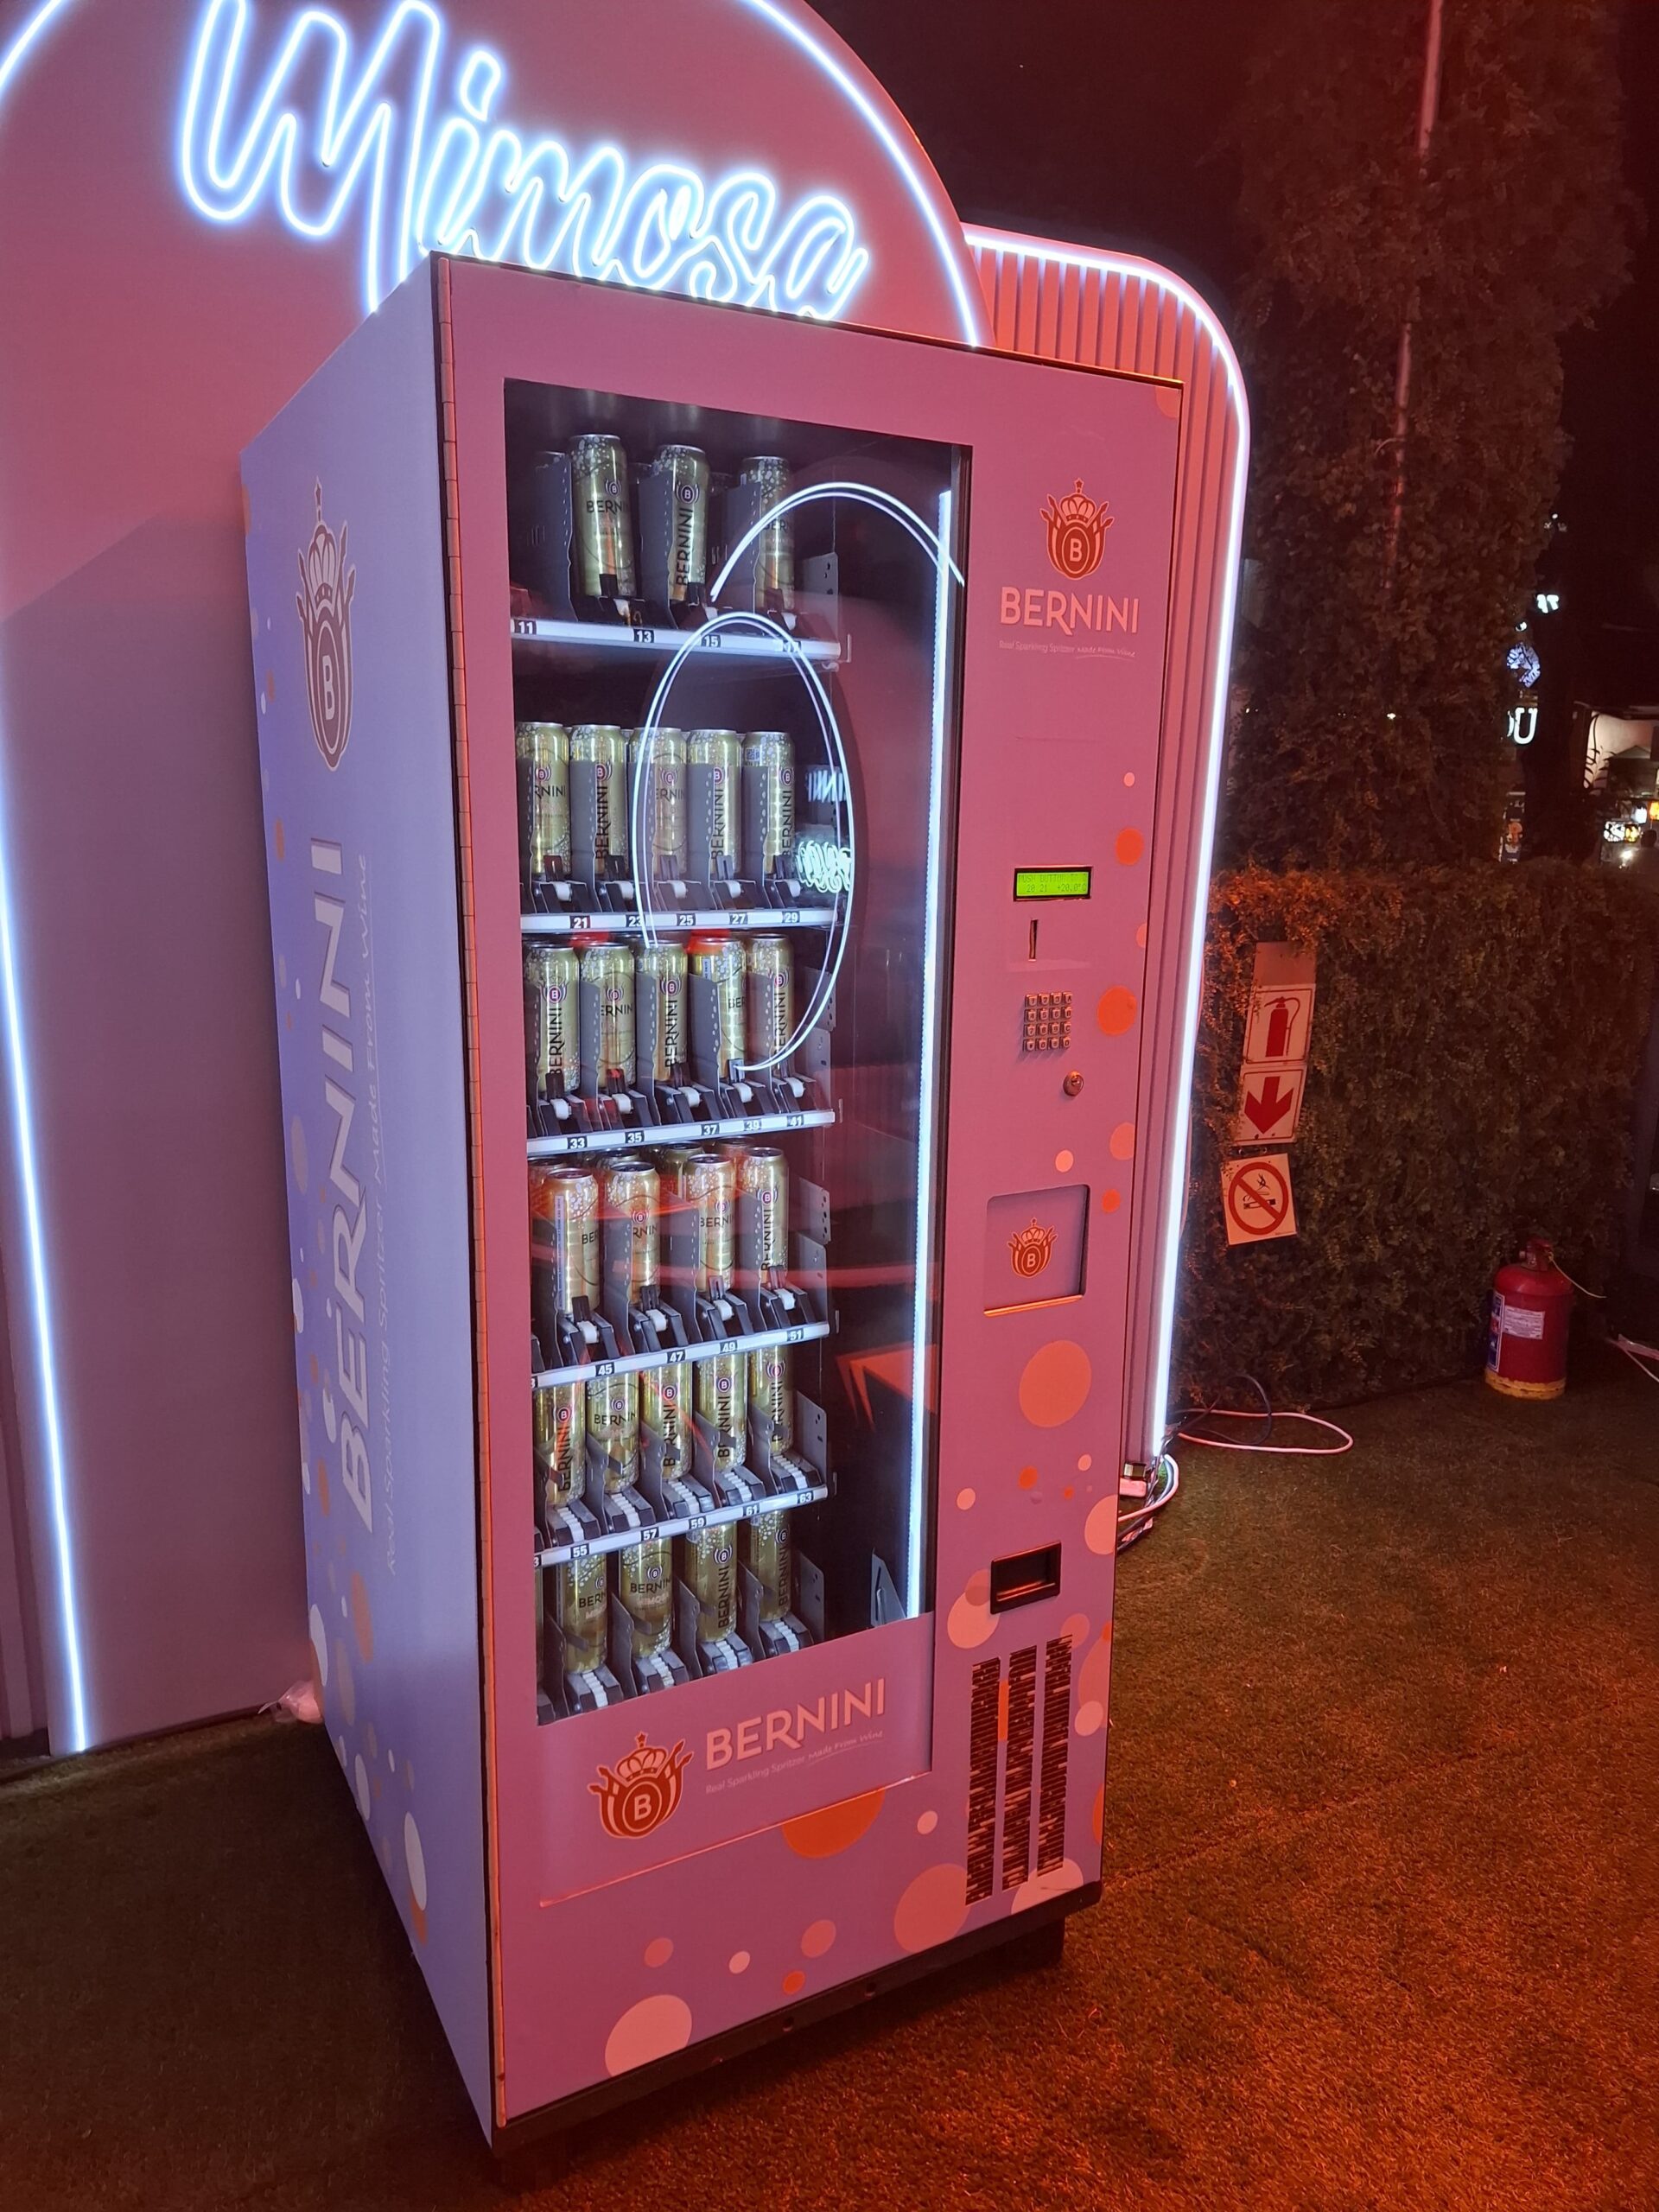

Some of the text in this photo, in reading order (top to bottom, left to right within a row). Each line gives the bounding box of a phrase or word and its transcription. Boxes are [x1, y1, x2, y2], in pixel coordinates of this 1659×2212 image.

[180, 0, 869, 320] Mimosa
[676, 507, 694, 586] BERNINI
[1069, 537, 1083, 563] B
[1000, 587, 1139, 636] BERNINI
[518, 621, 533, 634] 11
[637, 631, 652, 643] 13
[704, 636, 719, 647] 15
[595, 785, 612, 860] BERNINI
[710, 789, 726, 860] BERNINI
[358, 853, 371, 961] Wine
[574, 917, 588, 929] 21
[679, 914, 694, 926] 25
[732, 912, 746, 925] 27
[784, 912, 798, 923] 29
[361, 972, 376, 1072] From
[570, 1116, 803, 1149] 33 35 37 39 41
[310, 838, 373, 1534] BERNINI
[1027, 1253, 1036, 1268] B
[721, 1343, 736, 1353] 49
[790, 1330, 803, 1340] 51
[598, 1364, 613, 1375] 45
[670, 1351, 684, 1363] 47
[379, 1341, 396, 1495] Sparkling
[746, 1505, 759, 1516] 61
[798, 1492, 812, 1503] 63
[644, 1529, 658, 1541] 57
[691, 1517, 705, 1529] 59
[573, 1546, 588, 1557] 55
[718, 1565, 731, 1629] BERNINI
[706, 1678, 886, 1771] BERNINI
[727, 1767, 770, 1789] Sparkling
[633, 1793, 652, 1821] B
